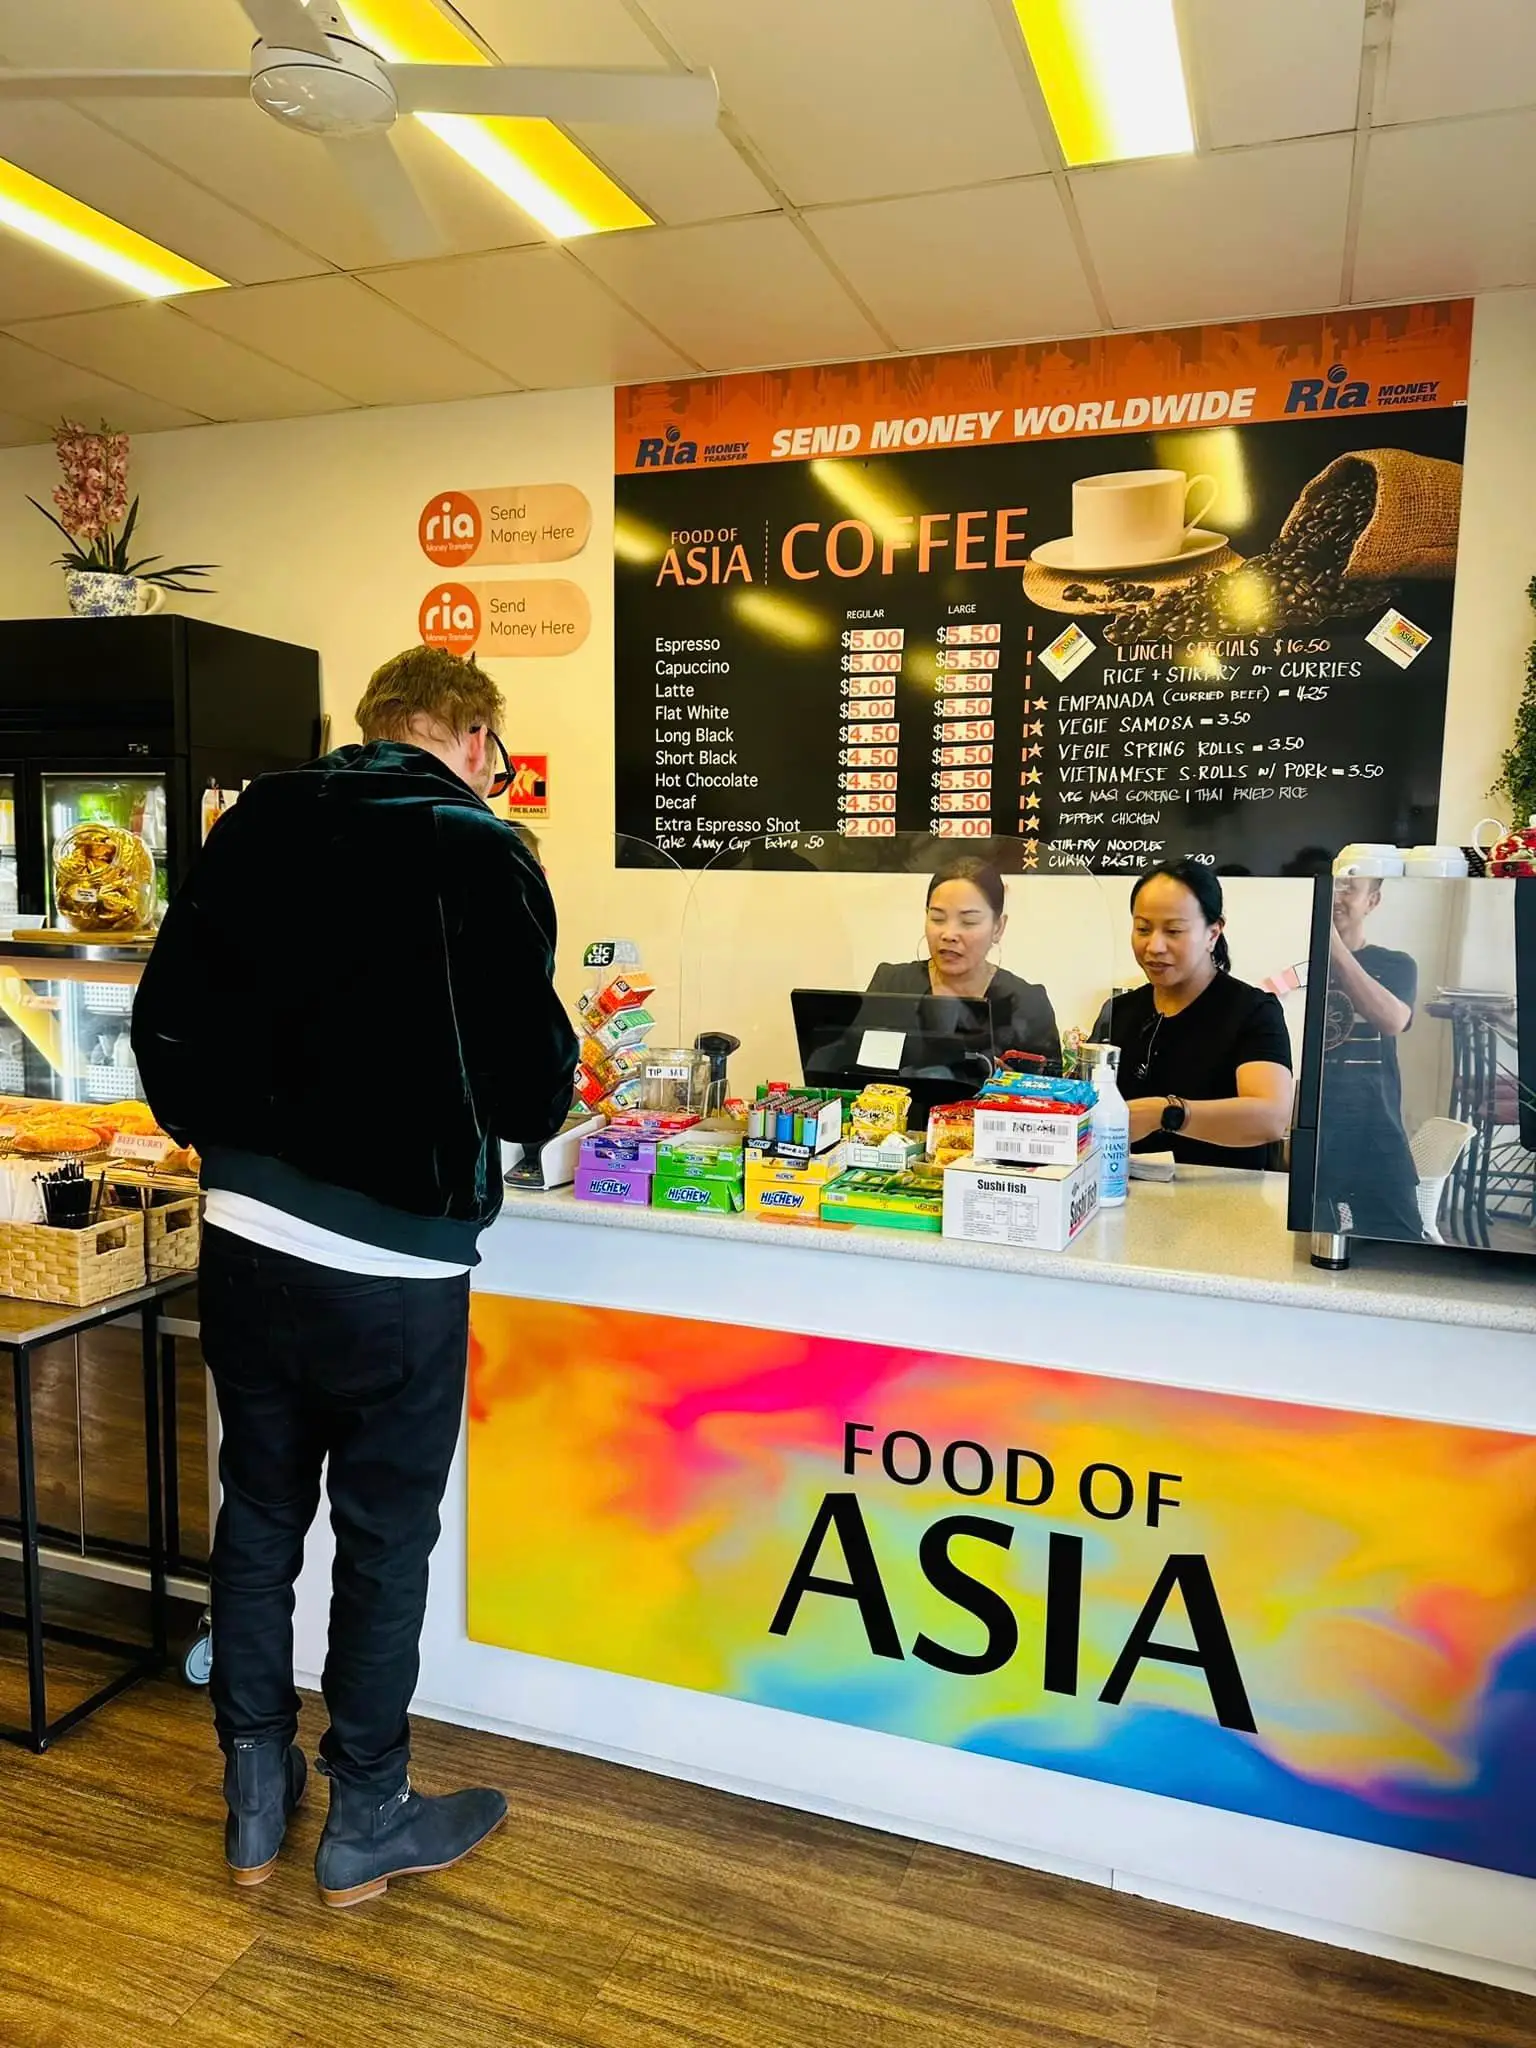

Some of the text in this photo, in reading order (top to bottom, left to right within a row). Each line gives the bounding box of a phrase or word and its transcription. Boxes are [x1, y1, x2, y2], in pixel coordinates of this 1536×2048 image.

[1284, 364, 1370, 413] Ria
[1378, 382, 1440, 397] MONEY
[1377, 394, 1438, 406] TRANSFER
[771, 387, 1256, 458] SEND MONEY WORLDWIDE
[635, 426, 698, 467] Ria
[704, 442, 749, 455] MONEY
[704, 453, 748, 463] TRANSFER
[426, 501, 474, 540] ria
[490, 505, 526, 520] Send
[490, 526, 574, 544] Money Here
[671, 527, 738, 545] FOOD OF
[781, 507, 1029, 581] COFFEE
[656, 544, 753, 587] ASIA
[425, 592, 474, 630] ria
[490, 599, 525, 613] Send
[847, 609, 885, 620] REGULAR
[948, 604, 977, 614] LARGE
[490, 621, 575, 638] Money Here
[655, 637, 720, 655] Espresso
[1117, 644, 1172, 662] LUNCH
[1186, 639, 1259, 659] SPECIALS
[655, 659, 730, 678] Capuccino
[1103, 668, 1146, 686] RICE
[1251, 665, 1272, 677] or
[1280, 661, 1362, 679] CURRIES
[655, 683, 695, 697] Latte
[1058, 691, 1154, 712] EMPANADA
[1163, 685, 1224, 706] (CURRIED
[1231, 685, 1270, 702] BEEF)
[655, 705, 682, 720] Flat
[687, 705, 729, 719] White
[1058, 717, 1108, 735] VEGIE
[1119, 715, 1194, 733] SAMOSA
[1217, 711, 1251, 726] 3.50
[655, 728, 691, 746] Long
[696, 727, 734, 742] Black
[655, 750, 694, 765] Short
[699, 749, 737, 765] Black
[1058, 743, 1109, 761] VEGIE
[1124, 741, 1185, 758] SPRING
[1198, 741, 1245, 757] ROLLS
[1267, 736, 1305, 751] 3.50
[655, 773, 681, 787] Hot
[686, 772, 759, 787] Chocolate
[1059, 767, 1168, 784] VIETNAMESE
[1284, 762, 1328, 779] PORK
[1348, 764, 1384, 779] 3.50
[655, 795, 697, 809] Decaf
[1126, 788, 1181, 802] GORENG
[1196, 787, 1223, 801] THAI
[1233, 786, 1274, 800] FRIED
[1279, 786, 1309, 799] RICE
[655, 817, 692, 831] Extra
[696, 817, 761, 834] Espresso
[766, 817, 801, 832] Shot
[1112, 812, 1160, 825] CHICKEN
[655, 835, 687, 849] Take
[728, 837, 751, 853] Cup
[765, 837, 798, 849] Extra
[804, 835, 824, 848] .50
[1107, 839, 1166, 851] NOODLES
[592, 944, 611, 955] tic
[587, 954, 610, 964] tac
[648, 1068, 662, 1076] TIP
[977, 1179, 1027, 1194] Sushi fish
[843, 1421, 1183, 1528] FOOD OF
[768, 1492, 1258, 1734] ASIA
